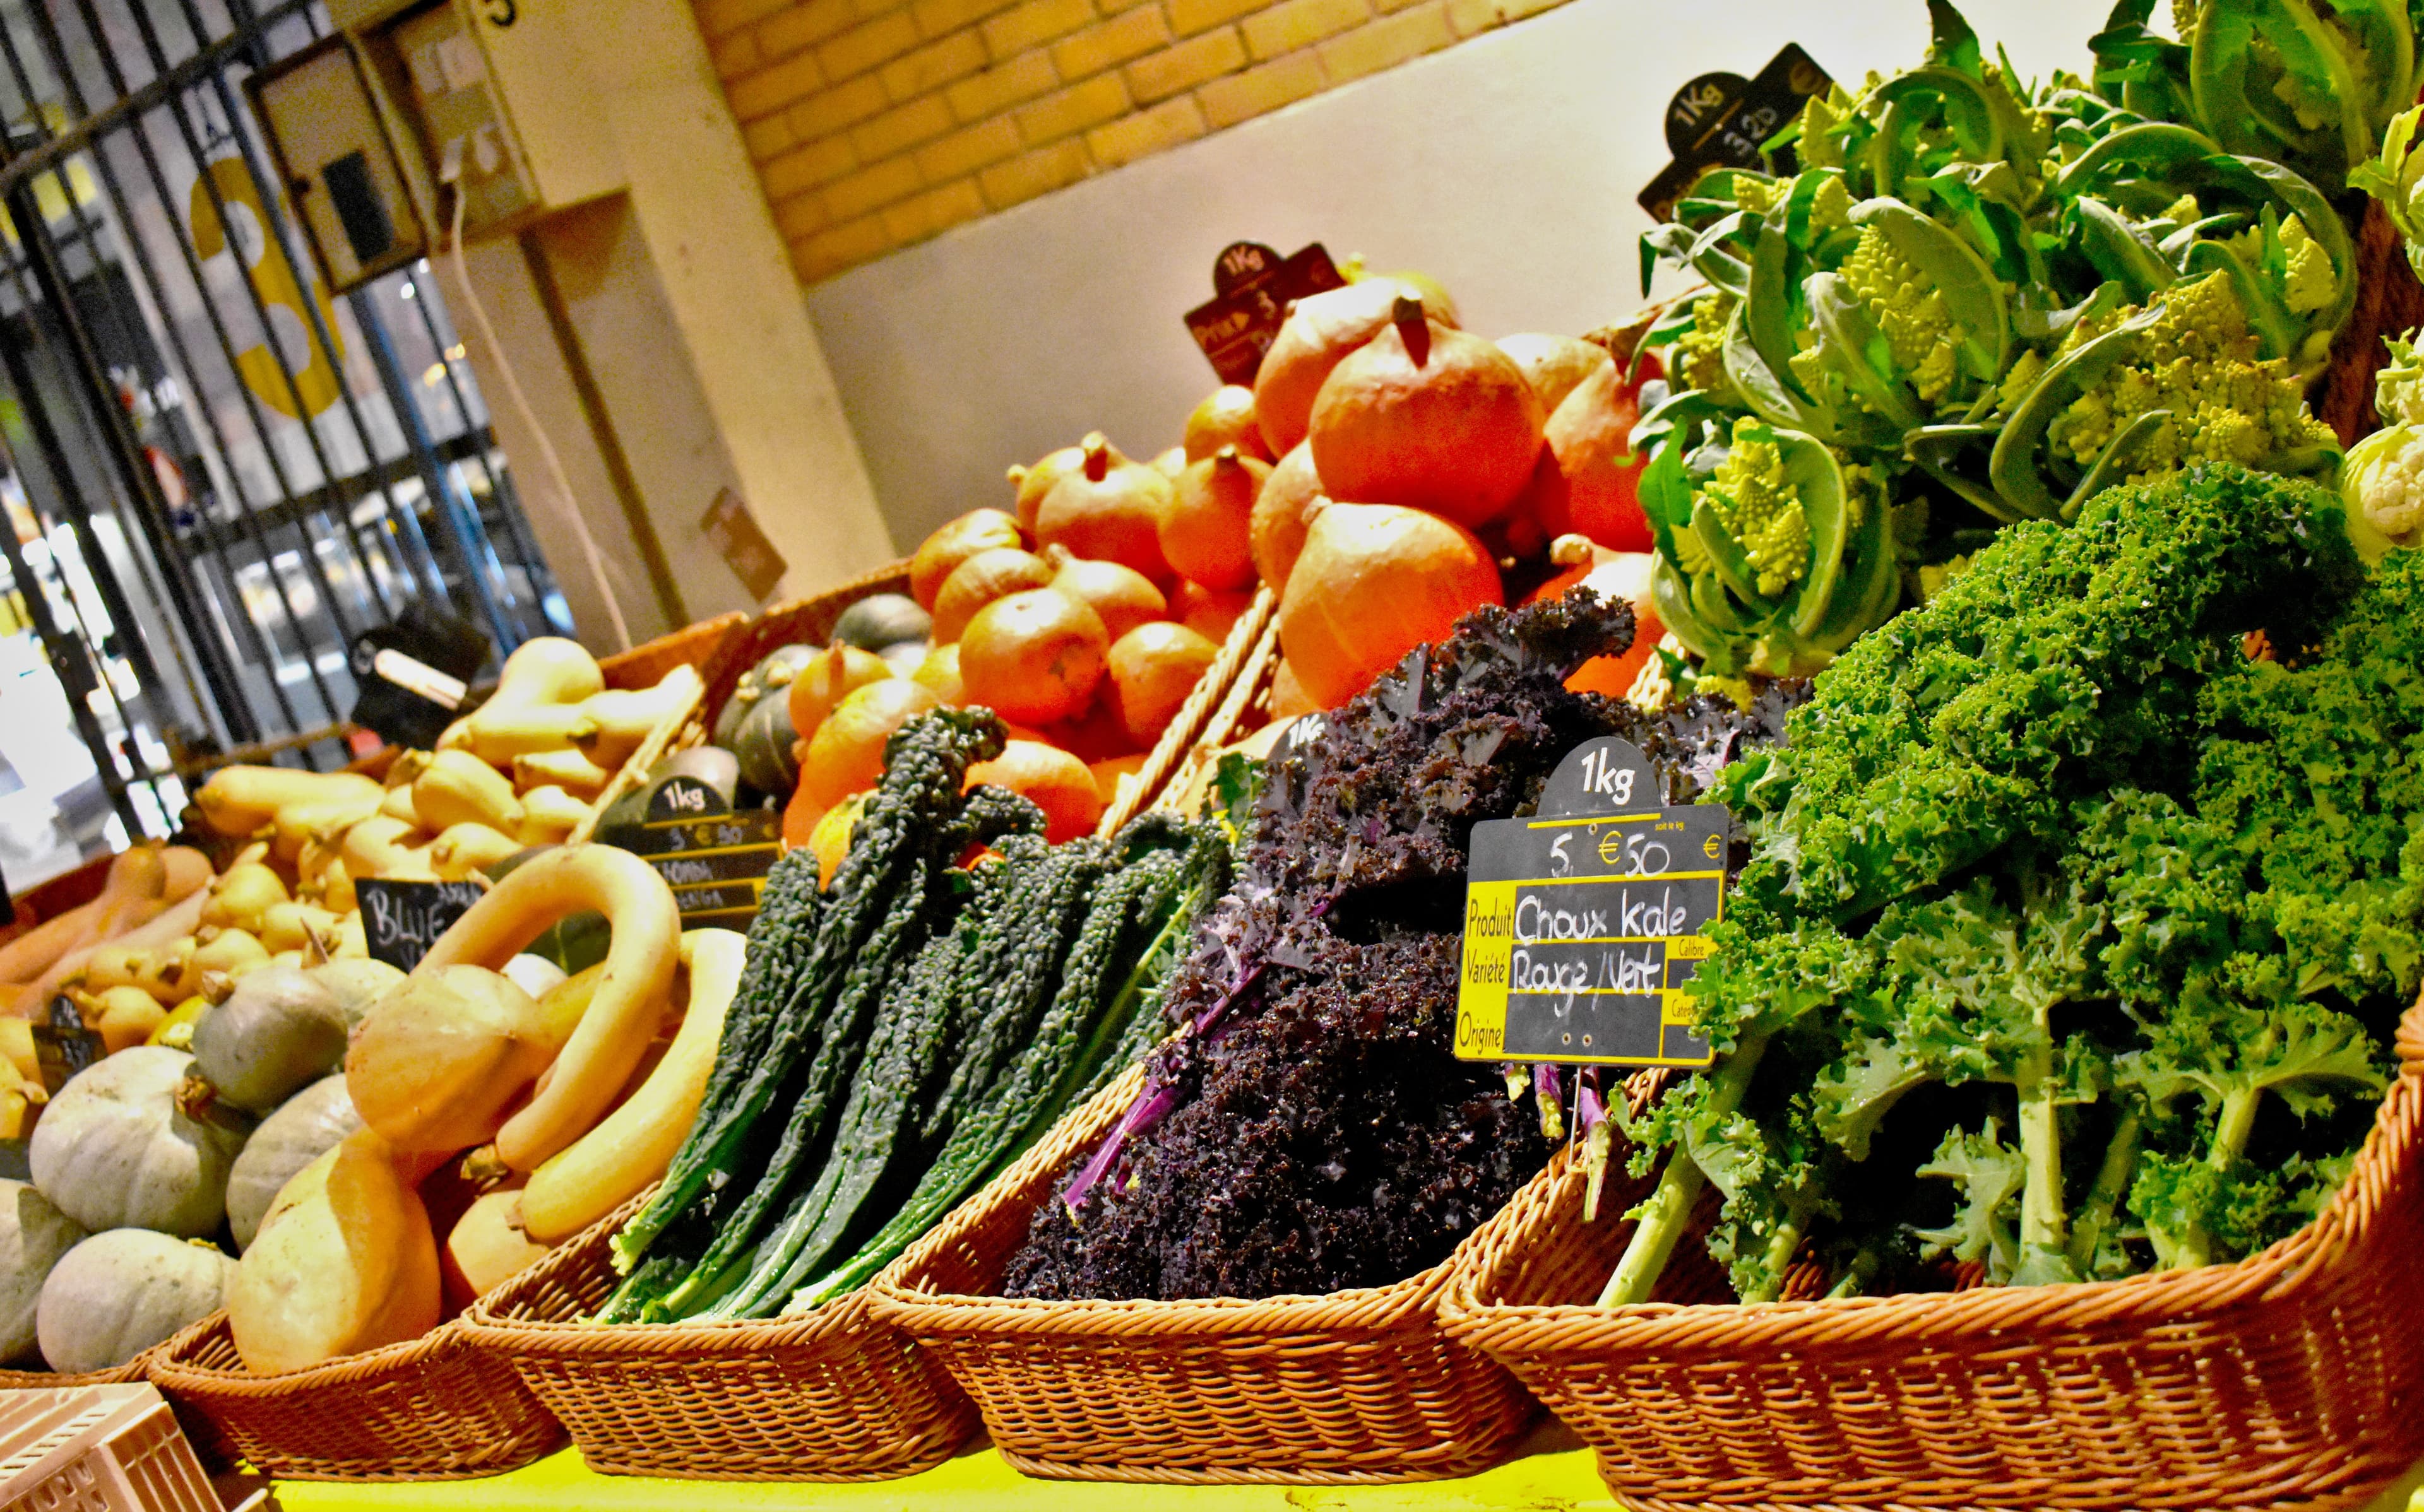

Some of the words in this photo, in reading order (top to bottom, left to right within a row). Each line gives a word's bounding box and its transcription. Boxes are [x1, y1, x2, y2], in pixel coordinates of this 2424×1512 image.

[1581, 747, 1636, 806] 1kg
[1625, 833, 1670, 878] 50
[1468, 897, 1512, 938] Produit
[1515, 895, 1608, 945] Choux
[1466, 948, 1506, 983] Variété
[1678, 938, 1704, 957] Calibre
[1459, 1011, 1501, 1055] Origine
